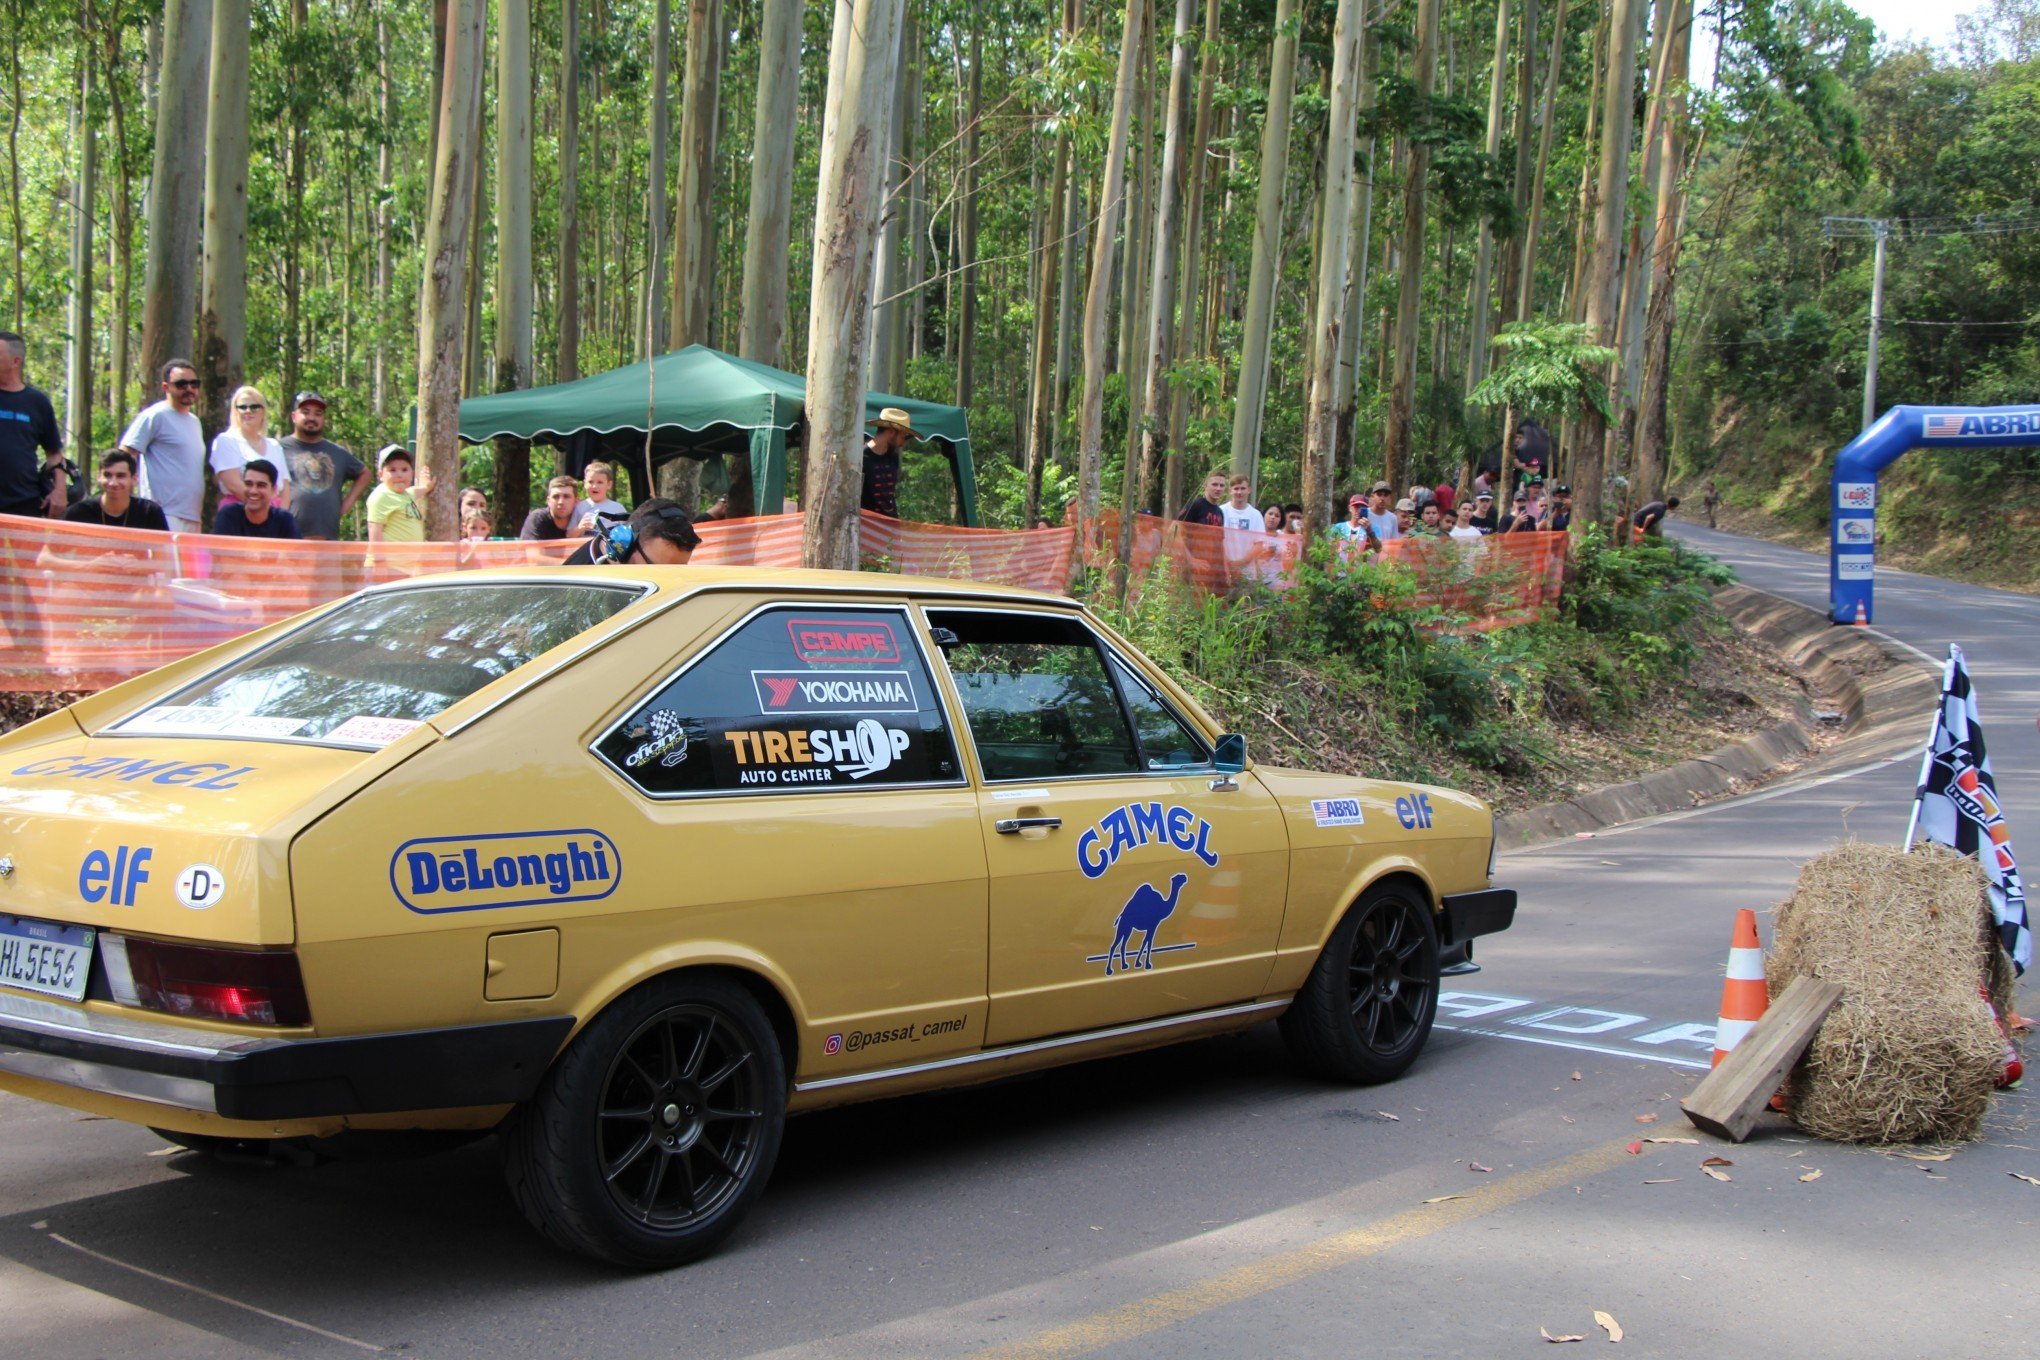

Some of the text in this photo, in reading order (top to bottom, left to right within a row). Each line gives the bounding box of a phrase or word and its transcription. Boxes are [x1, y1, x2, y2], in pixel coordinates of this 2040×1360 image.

[800, 631, 890, 651] COMPE
[798, 681, 909, 703] YOKOHAMA
[626, 727, 684, 767] oficina
[725, 719, 910, 771] TIRESHOP
[10, 755, 259, 790] CAMEL
[740, 768, 832, 783] AUTO CENTER
[1327, 800, 1360, 818] ABRO
[1396, 793, 1433, 829] elf
[1077, 802, 1219, 879] CAMEL
[79, 845, 153, 906] elf
[846, 1015, 967, 1052] @passat_camel
